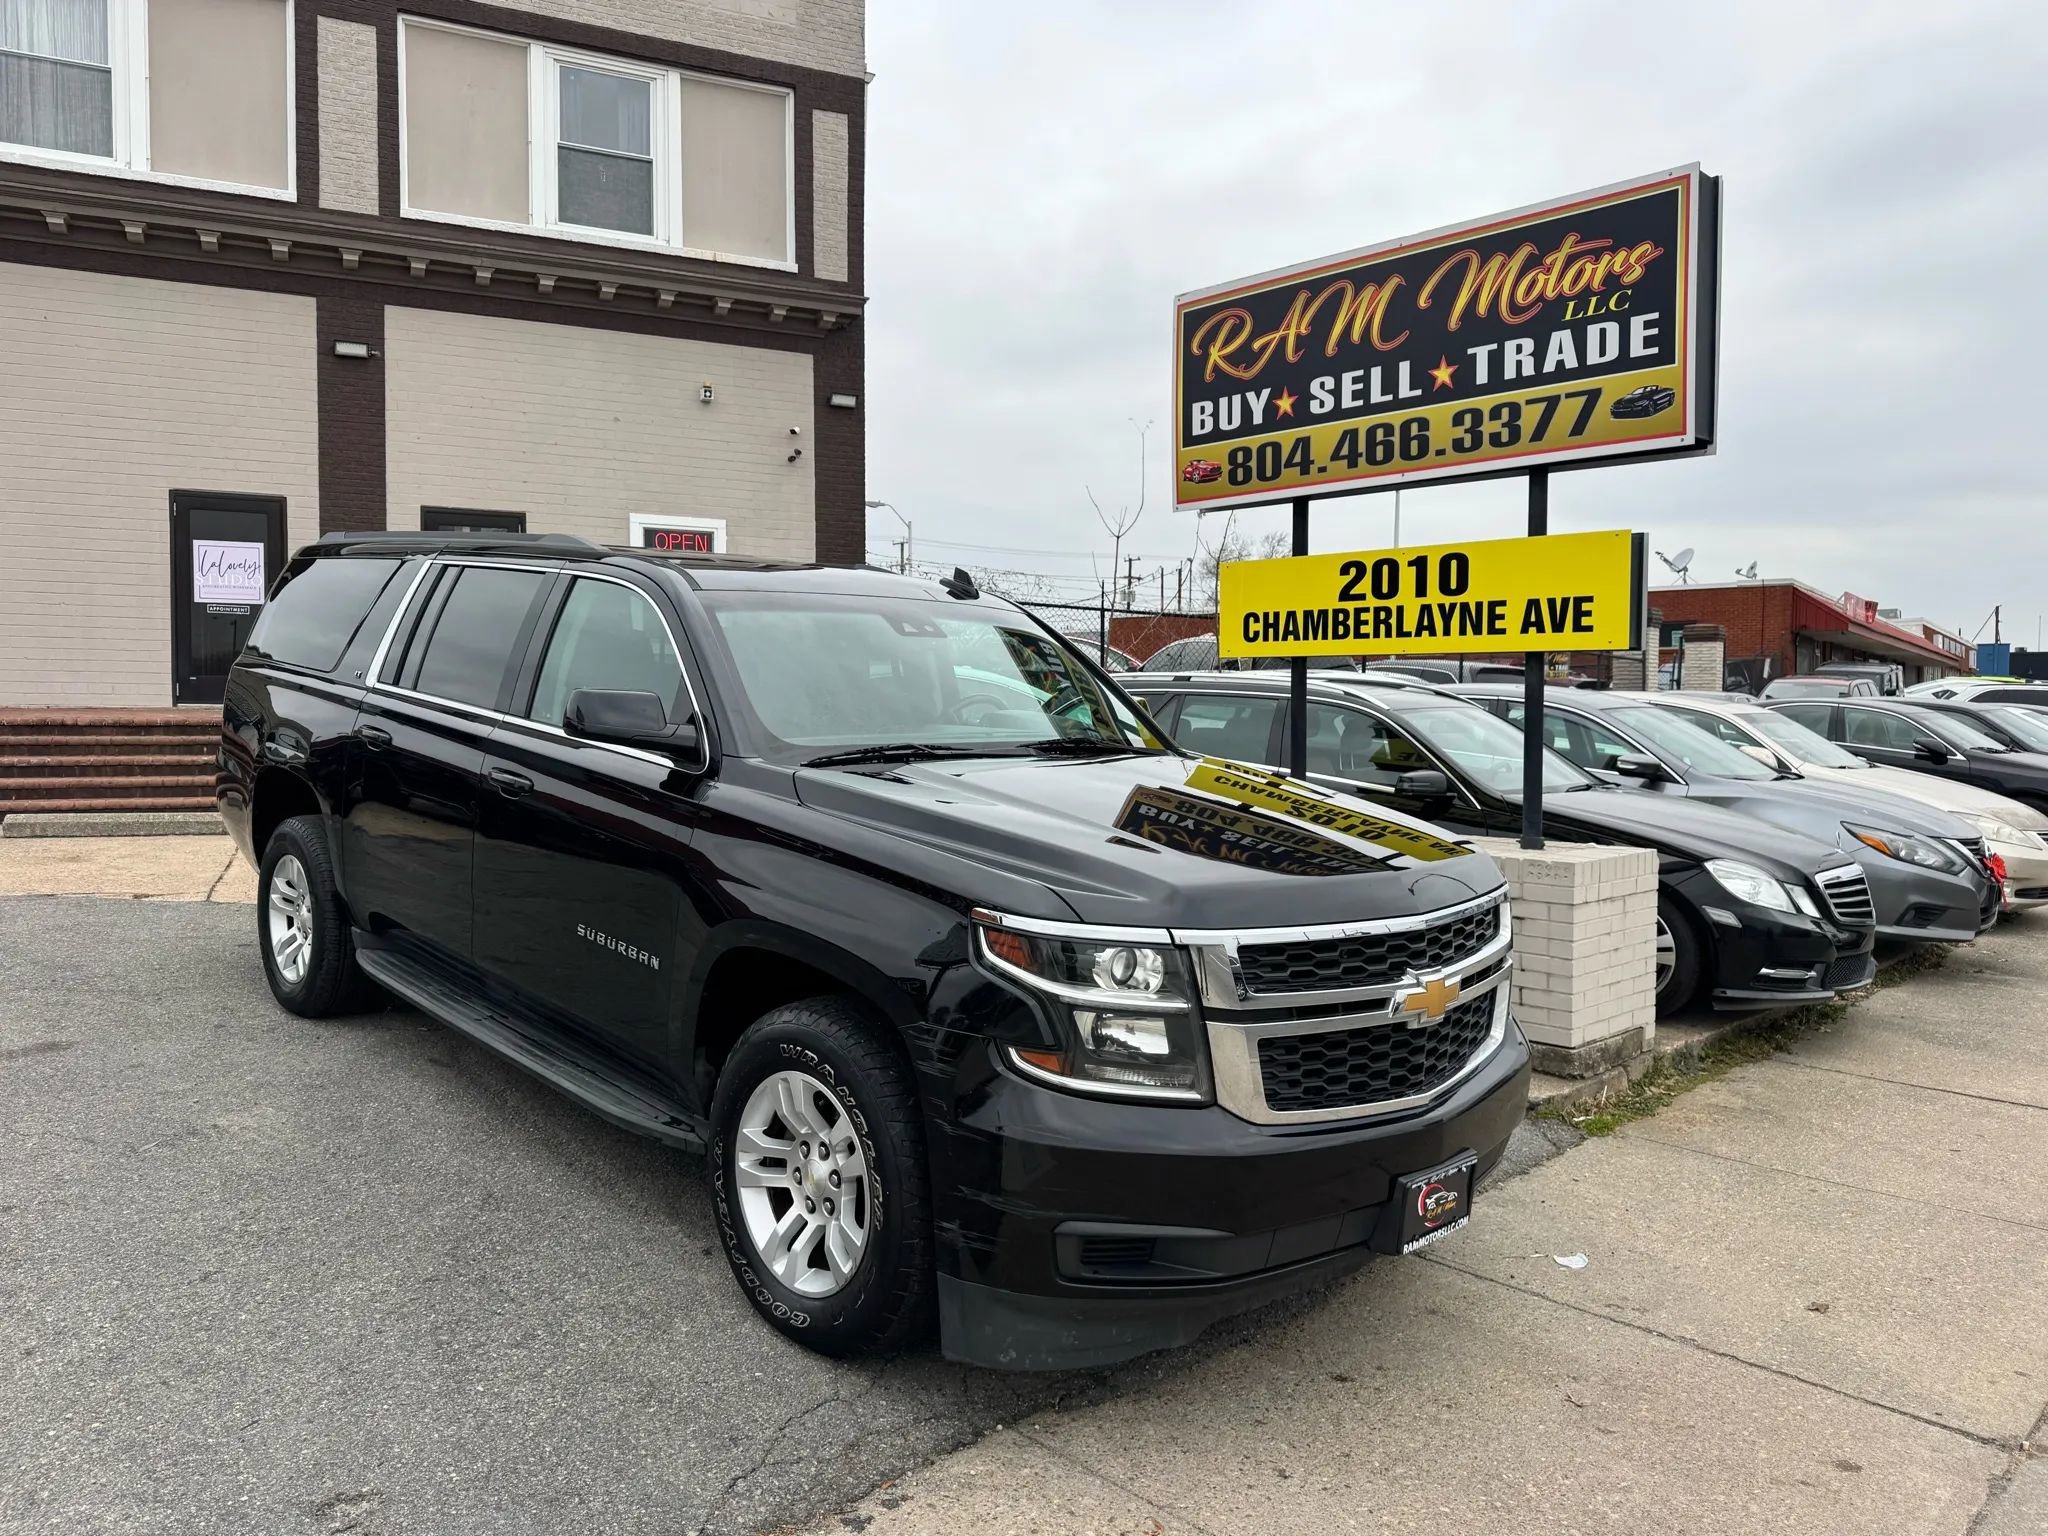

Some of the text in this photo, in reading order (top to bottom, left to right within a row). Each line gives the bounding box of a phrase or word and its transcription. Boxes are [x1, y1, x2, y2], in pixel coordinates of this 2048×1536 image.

[1191, 232, 1665, 383] RAM Motors
[1562, 289, 1633, 322] LLC
[1191, 311, 1661, 438] BUY SELL TRADE
[1226, 386, 1604, 488] 804.466.3377
[656, 532, 707, 552] OPEN
[1338, 552, 1470, 602] 2010
[1242, 595, 1595, 643] CHAMBERLAYNE AVE
[577, 923, 660, 970] SUBURBAN
